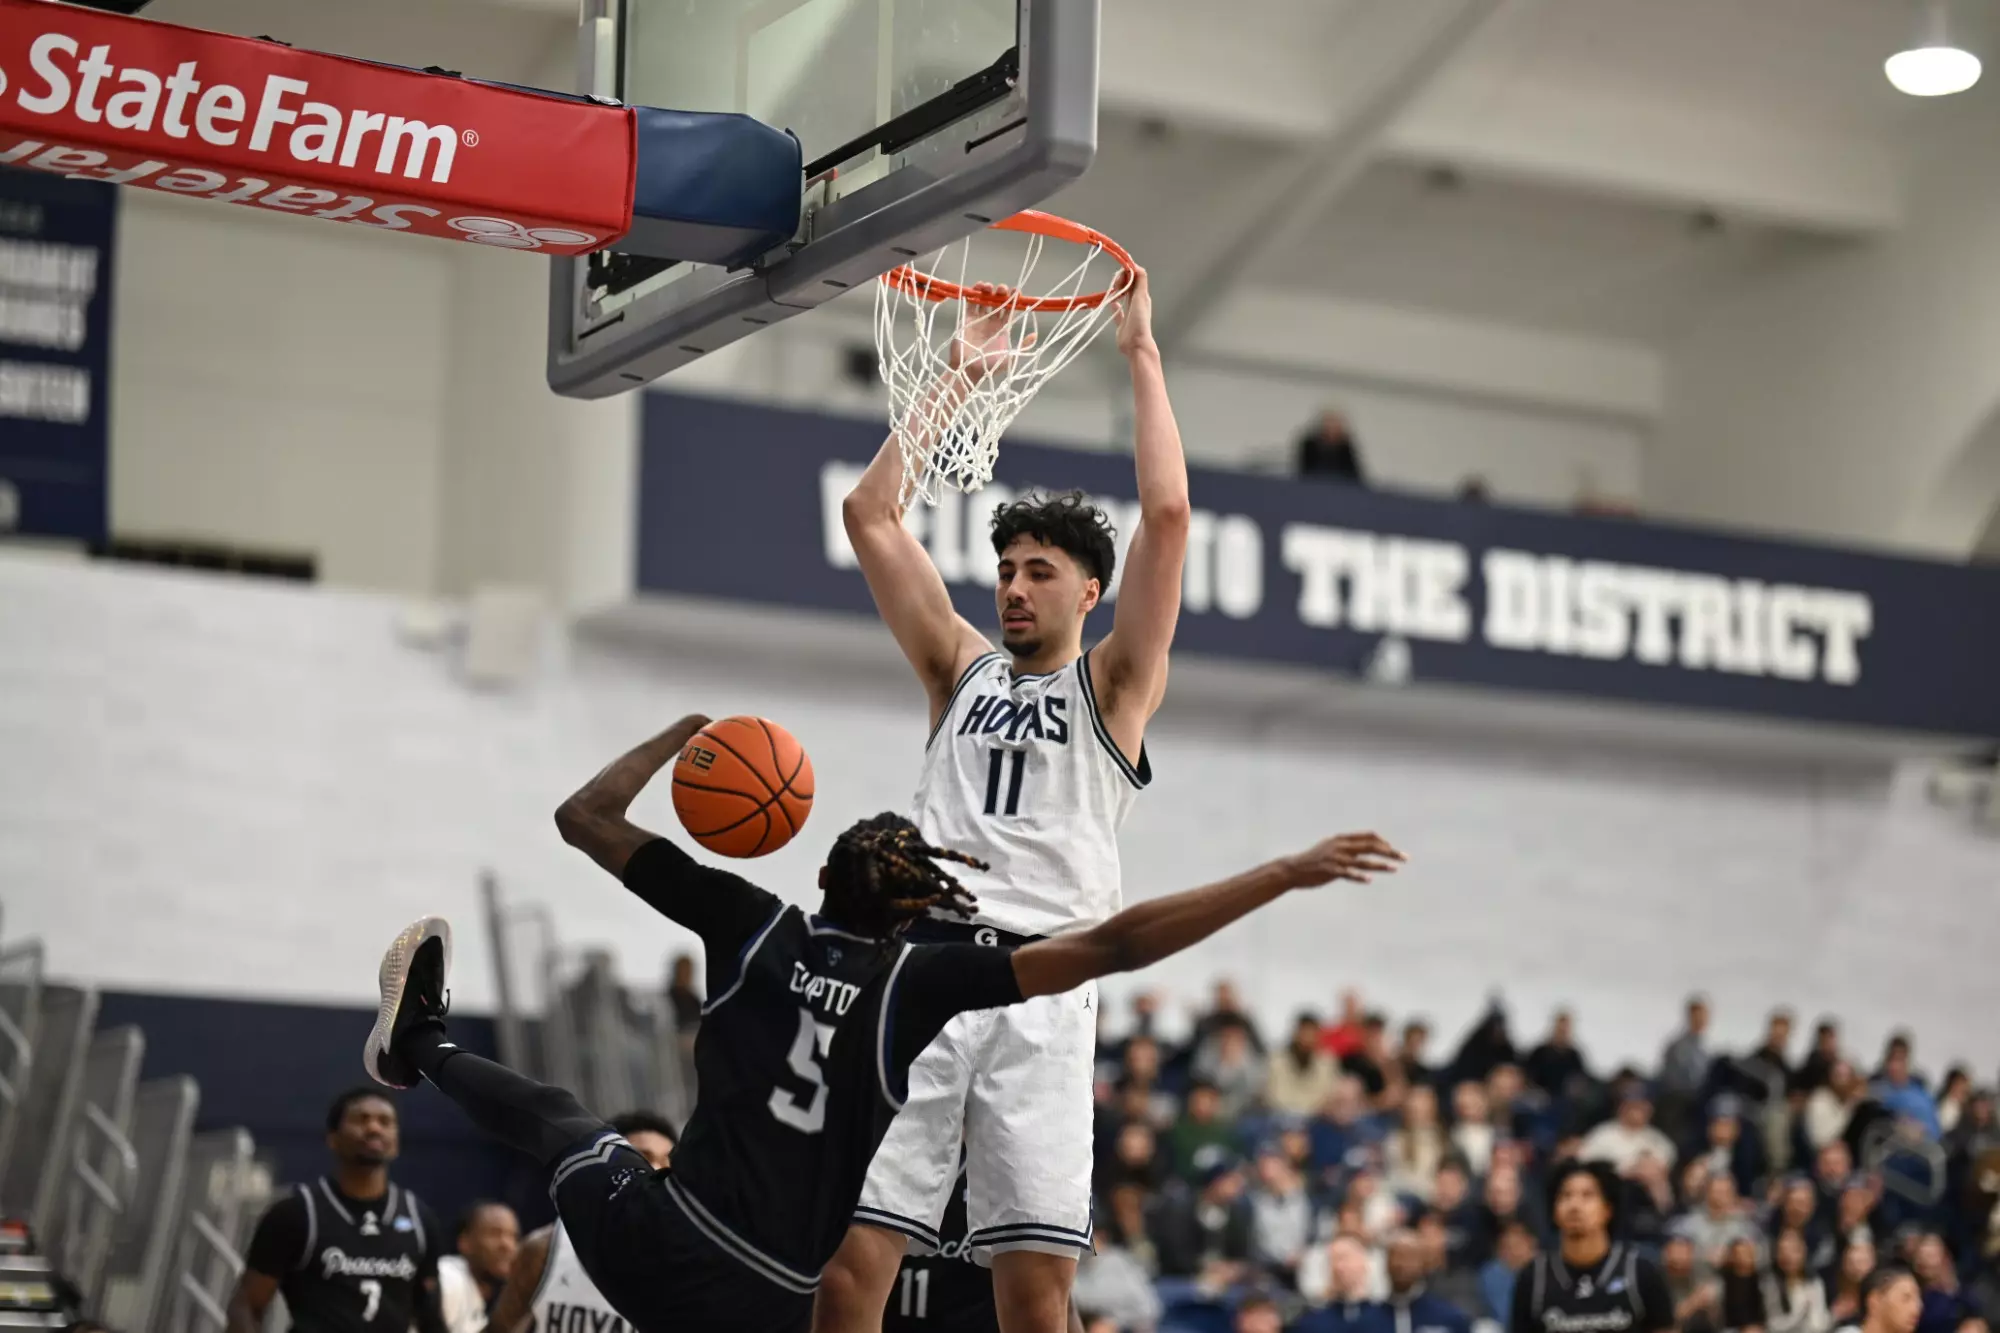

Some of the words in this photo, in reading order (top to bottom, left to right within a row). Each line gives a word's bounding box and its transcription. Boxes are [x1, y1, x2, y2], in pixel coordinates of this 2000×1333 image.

[1281, 523, 1471, 643] THE
[1483, 548, 1872, 684] DISTRICT
[957, 695, 1068, 745] HOYAS
[983, 748, 1026, 816] 11
[767, 1006, 837, 1134] 5
[360, 1279, 382, 1321] 7
[901, 1268, 930, 1318] 11
